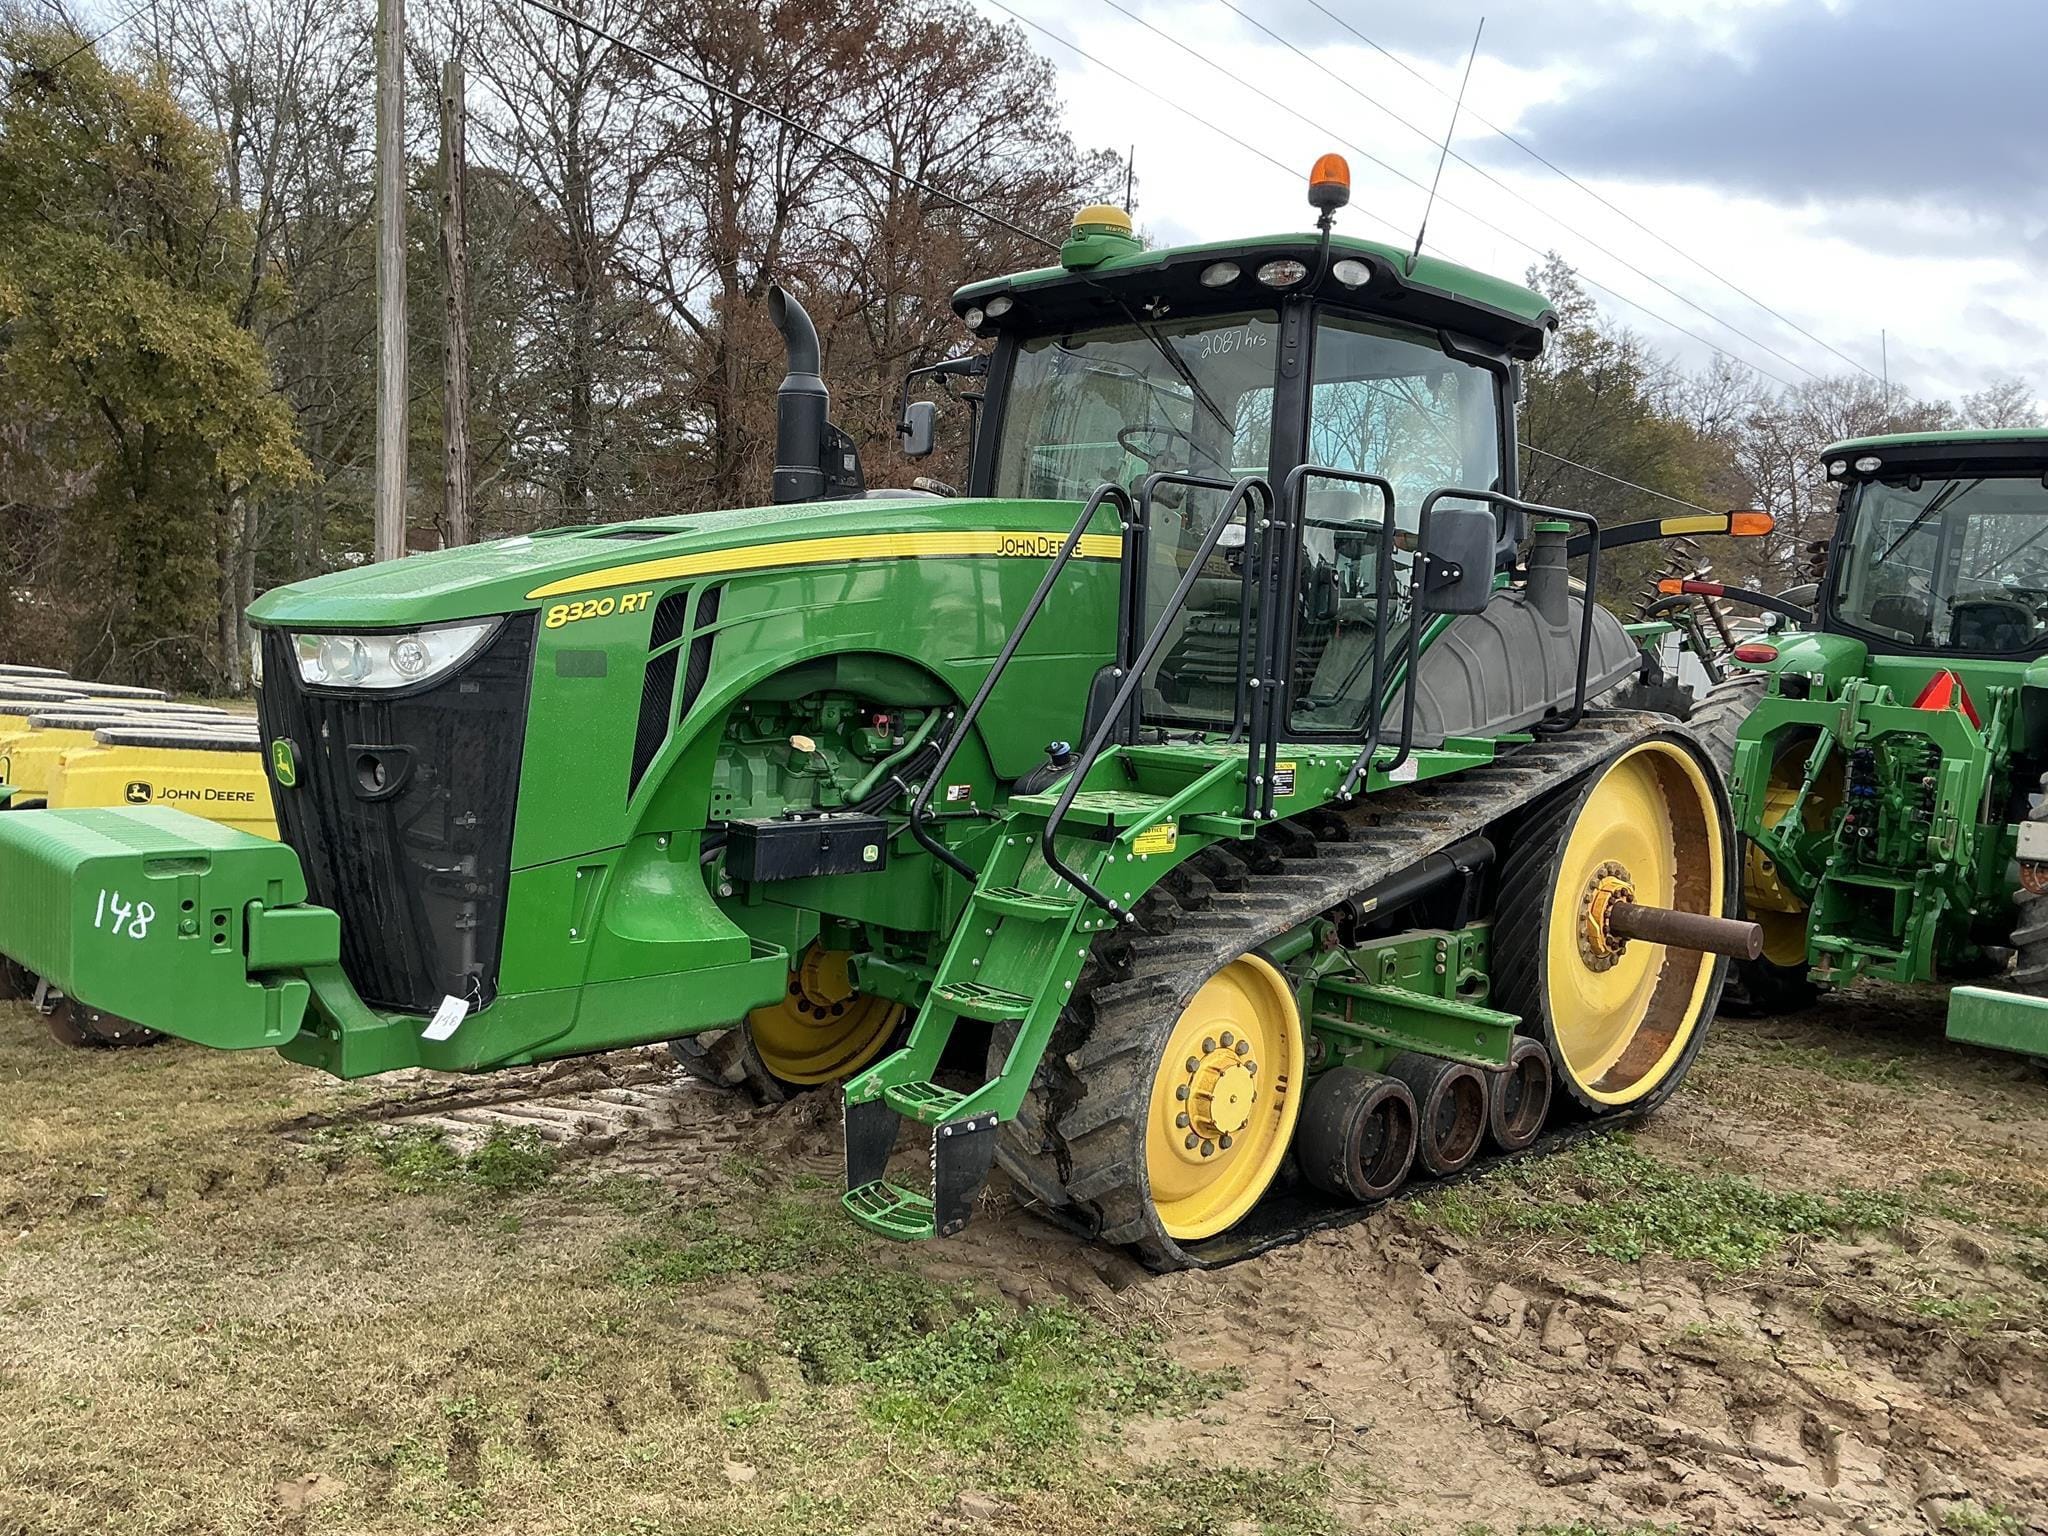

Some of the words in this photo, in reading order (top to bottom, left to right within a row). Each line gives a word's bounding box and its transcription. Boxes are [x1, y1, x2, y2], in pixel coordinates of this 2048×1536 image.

[1200, 330, 1242, 359] 2087
[1245, 327, 1267, 348] hrs
[996, 536, 1035, 554] JOHN
[545, 597, 616, 630] 8320
[618, 591, 655, 615] RT
[156, 787, 201, 800] JOHN
[204, 788, 256, 802] DEERE
[94, 888, 156, 939] 148
